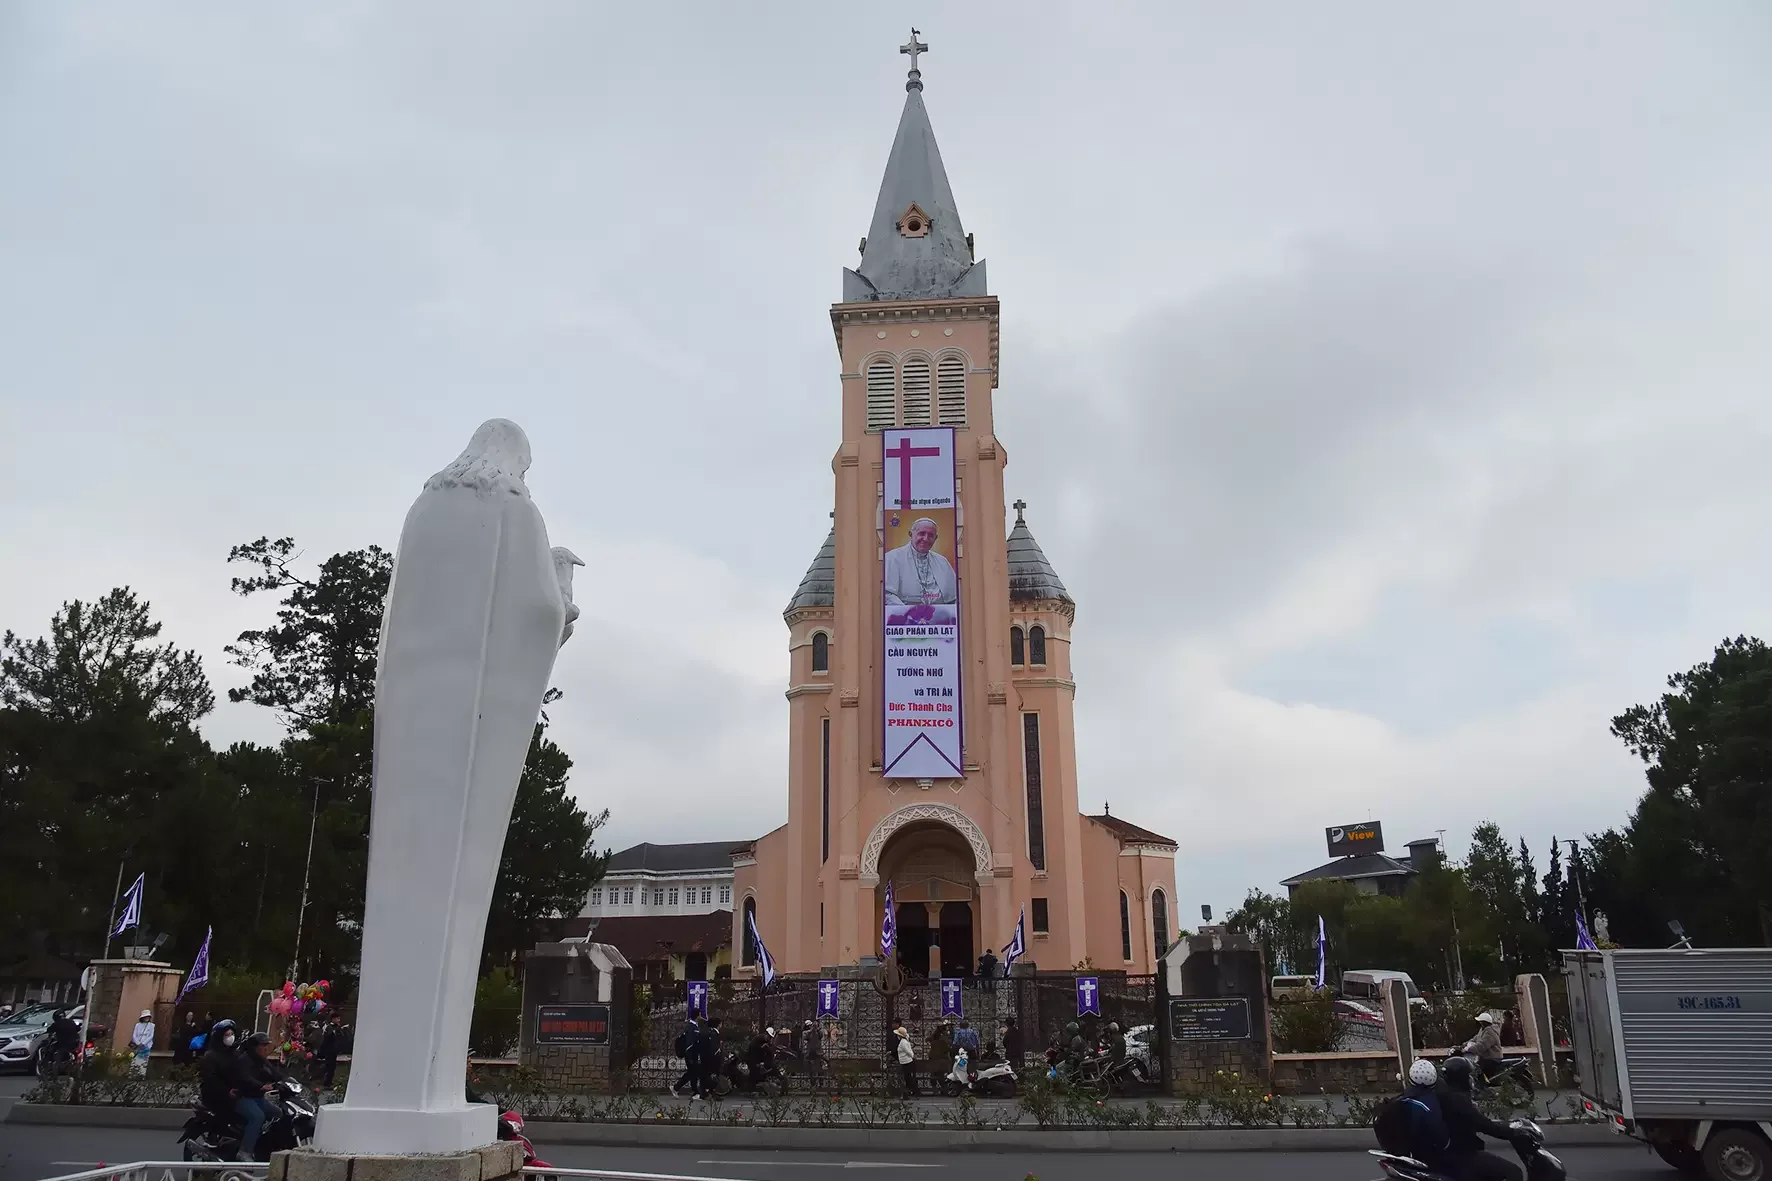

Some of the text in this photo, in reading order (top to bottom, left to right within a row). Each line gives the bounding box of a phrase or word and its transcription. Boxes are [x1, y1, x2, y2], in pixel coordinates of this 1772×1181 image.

[906, 626, 926, 637] PHẬN
[928, 626, 939, 635] ĐÀ
[940, 626, 954, 637] LẠT
[907, 647, 938, 658] NGUYỆN
[926, 666, 944, 677] NHỚ
[926, 687, 940, 697] TRI
[936, 702, 953, 712] Cha
[887, 718, 954, 728] PHANXICÔ
[1347, 831, 1375, 841] View
